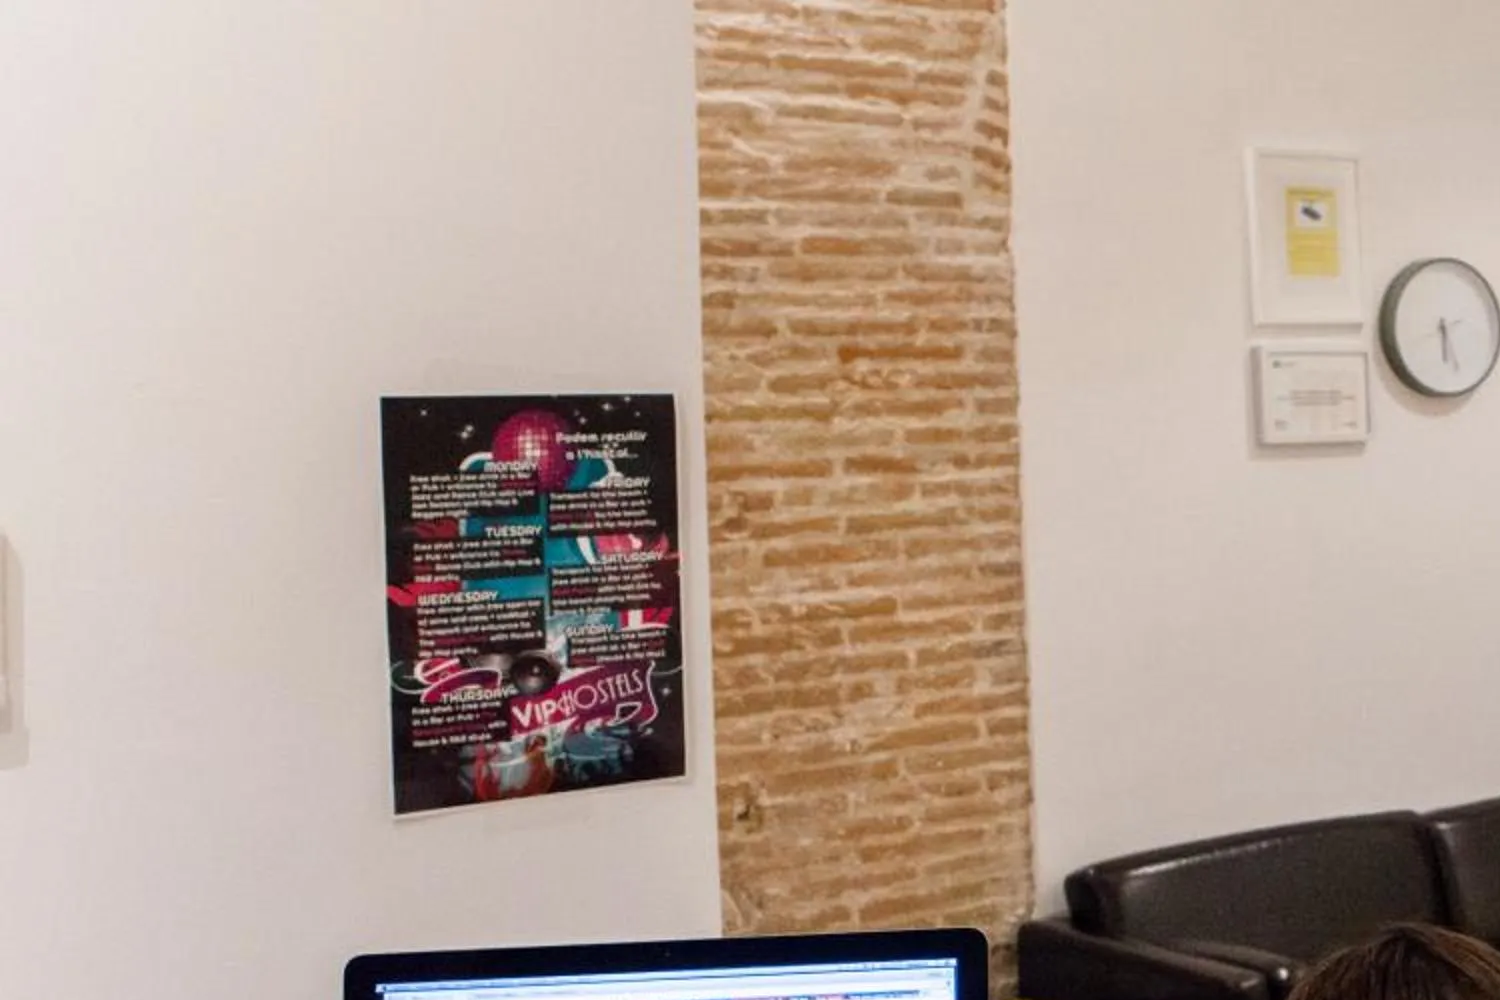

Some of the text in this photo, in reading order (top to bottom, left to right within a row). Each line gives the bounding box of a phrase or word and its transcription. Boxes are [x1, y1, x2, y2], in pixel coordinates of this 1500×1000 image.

[484, 525, 542, 538] TUESDAY
[417, 590, 498, 606] WEDNESDAY
[441, 685, 508, 704] THURSDAY
[511, 667, 644, 729] VIP HOSTELS
